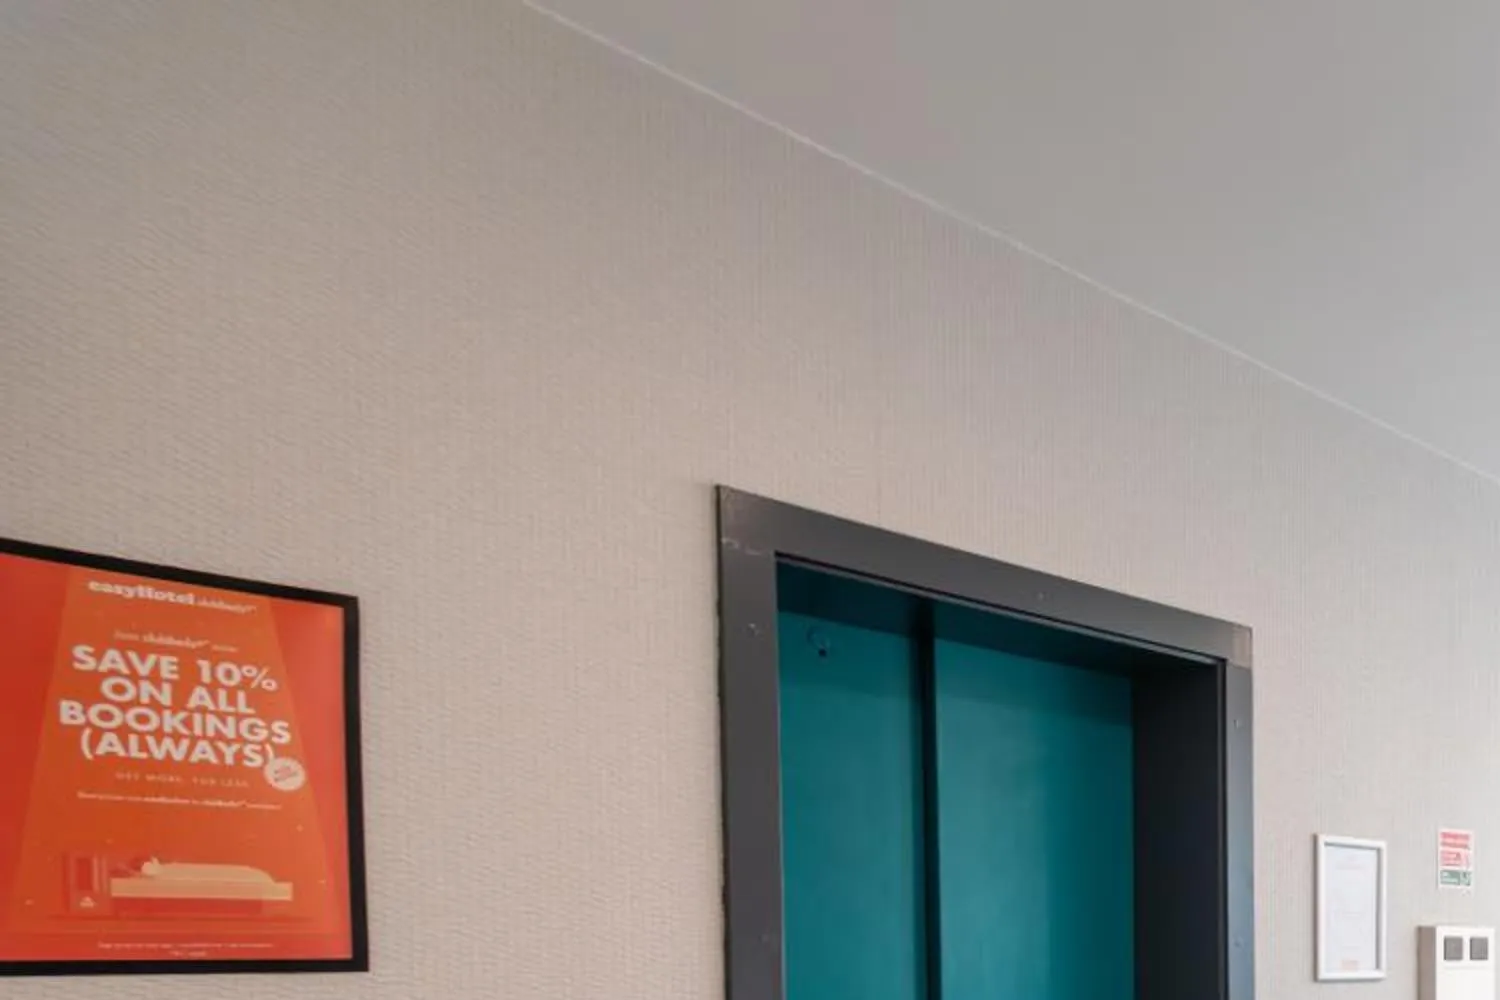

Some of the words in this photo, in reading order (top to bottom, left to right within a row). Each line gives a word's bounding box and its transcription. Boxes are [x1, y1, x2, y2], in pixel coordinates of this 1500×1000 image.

[87, 580, 195, 605] easyHotel
[72, 644, 180, 680] SAVE
[196, 659, 278, 692] 10%
[100, 676, 173, 707] ON
[187, 685, 256, 714] ALL
[59, 700, 291, 745] BOOKINGS
